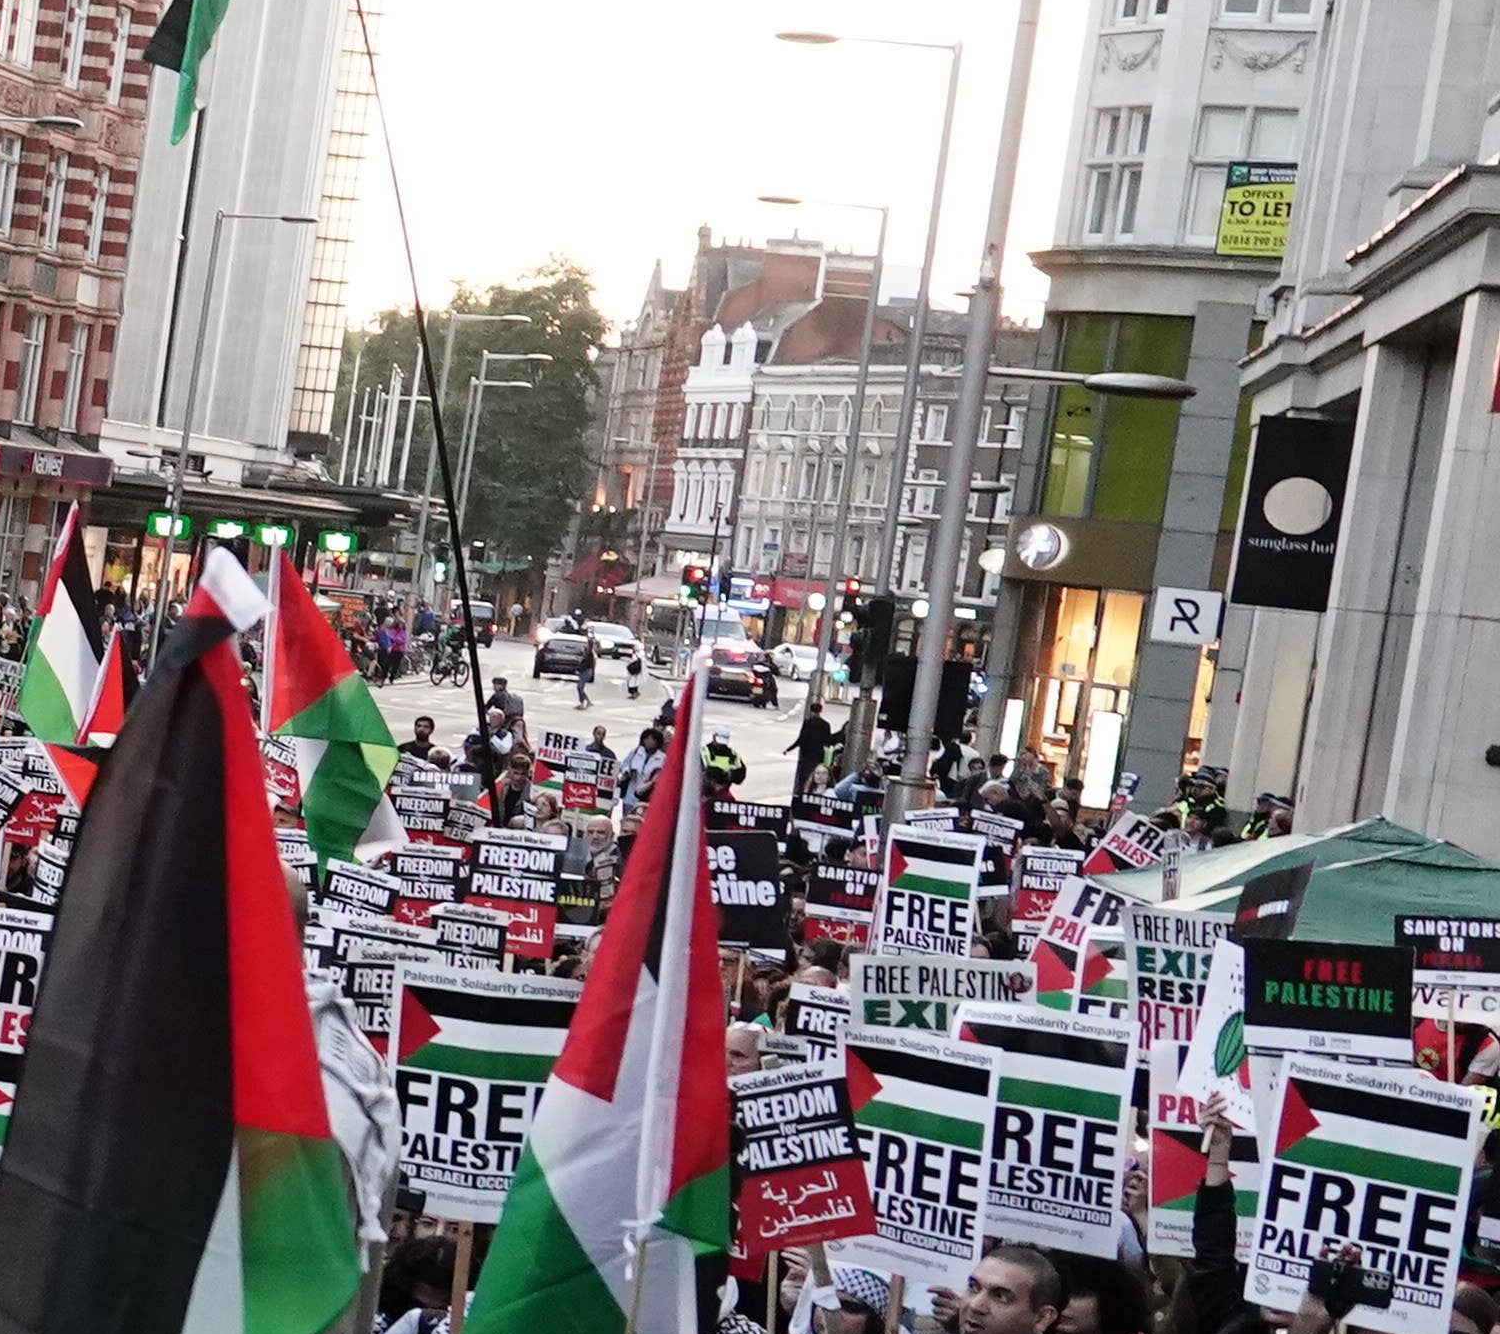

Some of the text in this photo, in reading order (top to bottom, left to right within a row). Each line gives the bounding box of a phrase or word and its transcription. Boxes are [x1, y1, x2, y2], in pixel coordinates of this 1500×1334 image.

[1242, 190, 1284, 199] OFFICES
[1229, 201, 1292, 217] TO LET
[1247, 535, 1335, 555] sunglass hut
[545, 731, 579, 750] FREE
[713, 801, 783, 820] SANCTIONS
[397, 857, 454, 877] FREEDOM
[478, 846, 554, 871] FREEDOM
[1026, 857, 1079, 874] FREEDOM
[329, 875, 390, 907] FREEDOM
[471, 874, 557, 901] PALESTINE
[846, 880, 865, 894] ON
[884, 890, 969, 938] FREE
[437, 922, 500, 948] FREEDOM
[883, 928, 967, 956] PALESTINE
[1134, 917, 1171, 944] FREE
[1403, 918, 1500, 939] SANCTIONS
[1440, 937, 1465, 953] ON
[862, 970, 914, 997] FREE
[1304, 958, 1364, 985] FREE
[403, 969, 581, 1002] Palestine Solidarity Campaign
[1264, 980, 1395, 1014] PALESTINE
[1012, 1011, 1131, 1041] Solidarity Campaign
[845, 1029, 993, 1067] Palestine Solidarity Campaign
[732, 1066, 824, 1092] Socialist Worker
[1289, 1062, 1474, 1108] Palestine Solidarity Campaign
[420, 1165, 474, 1187] ISRAELI
[761, 1171, 839, 1203] الحرية
[758, 1199, 856, 1240] لفلسطين
[1021, 1196, 1112, 1227] OCCUPATION
[1264, 1163, 1457, 1259] FREE
[901, 1230, 974, 1262] OCCUPATION
